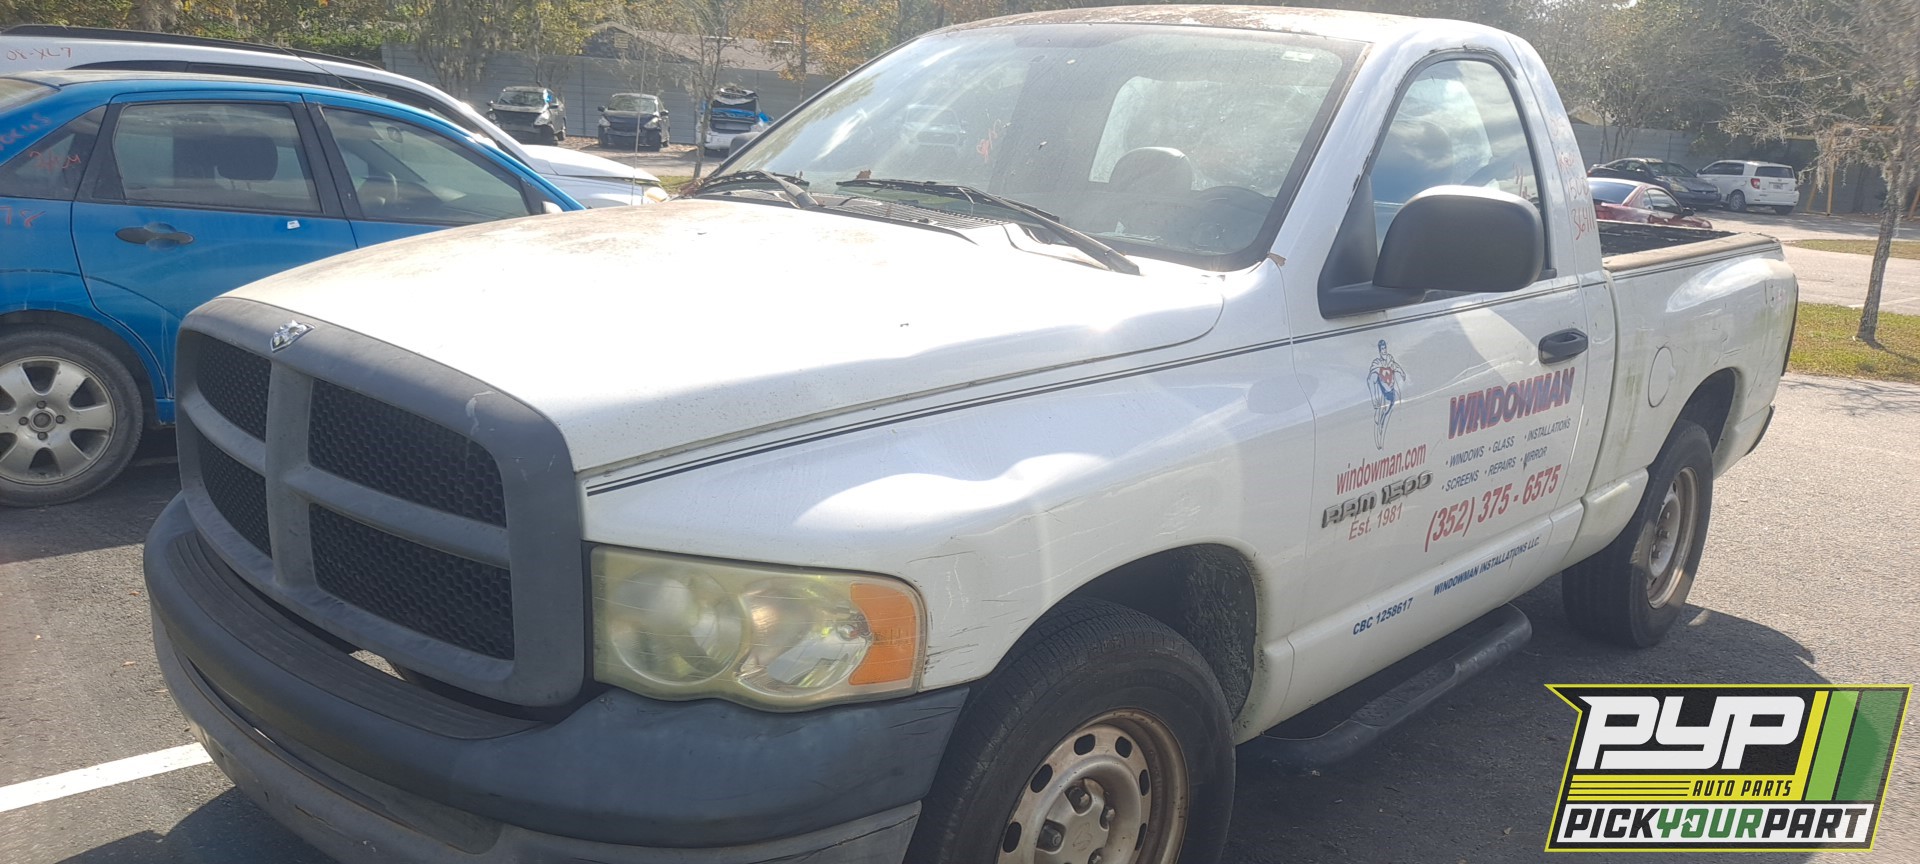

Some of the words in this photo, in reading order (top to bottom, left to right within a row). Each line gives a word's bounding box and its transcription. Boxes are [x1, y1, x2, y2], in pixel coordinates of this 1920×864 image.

[1448, 367, 1575, 440] WINDOWMAN
[1450, 446, 1485, 468] WINDOWS
[1492, 436, 1515, 453] GLASS
[1527, 417, 1571, 441] INSTALLATIONS
[1337, 444, 1426, 496] windowman.com
[1445, 470, 1479, 492] SCREENS
[1487, 457, 1517, 476] REPAIRS
[1524, 446, 1548, 465] MIRROR
[1321, 491, 1377, 529] RAM
[1381, 470, 1433, 505] 1500
[1349, 517, 1371, 540] Est.
[1378, 502, 1403, 528] 1981
[1425, 497, 1475, 552] (352)
[1478, 483, 1512, 523] 375
[1522, 464, 1562, 506] 6575
[1434, 564, 1479, 596] WINDOWMAN
[1479, 540, 1527, 573] INSTALLATIONS
[1353, 616, 1373, 635] CBC
[1376, 597, 1413, 624] 1258617
